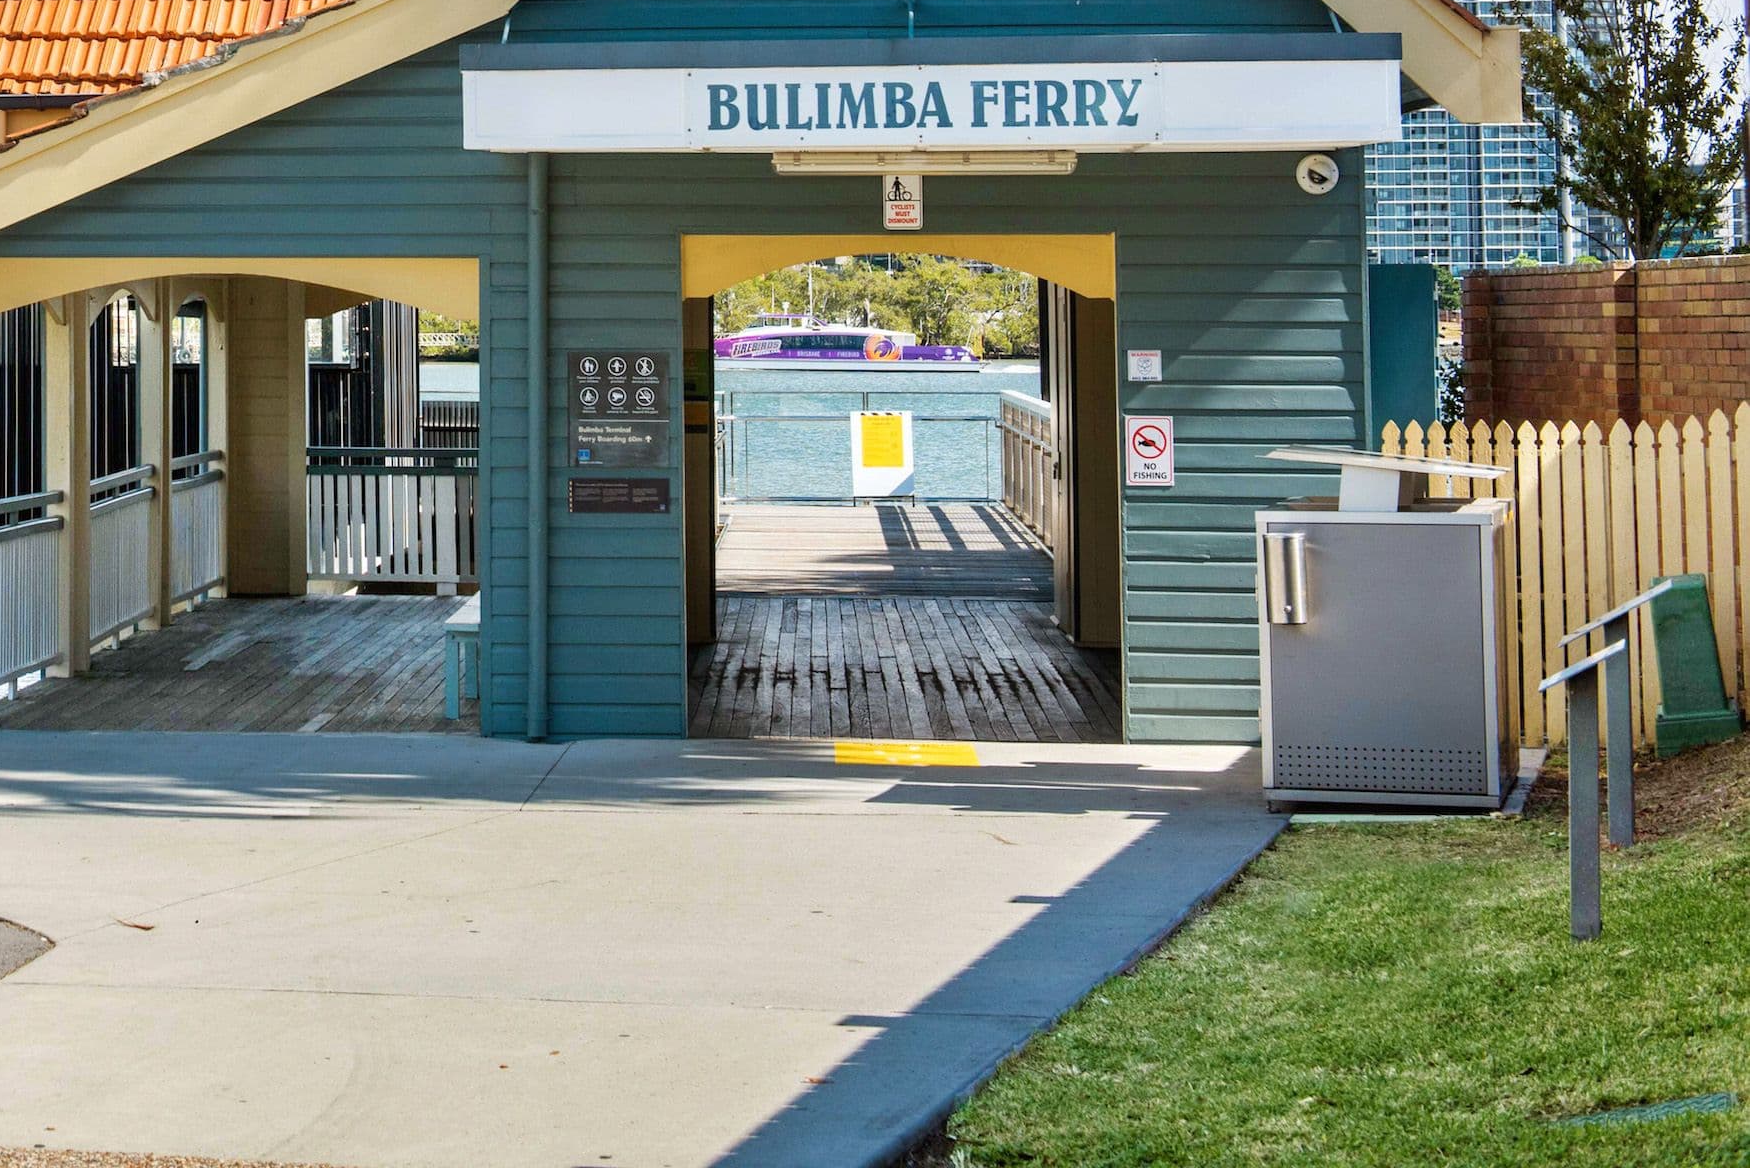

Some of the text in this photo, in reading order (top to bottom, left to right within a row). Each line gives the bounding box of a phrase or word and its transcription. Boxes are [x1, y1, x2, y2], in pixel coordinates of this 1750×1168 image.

[706, 79, 1142, 131] BULIMBA FERRY
[732, 341, 780, 356] FIREBIRDS
[578, 435, 596, 443] Ferry
[597, 435, 627, 443] Boarding
[1133, 472, 1167, 480] FISHING
